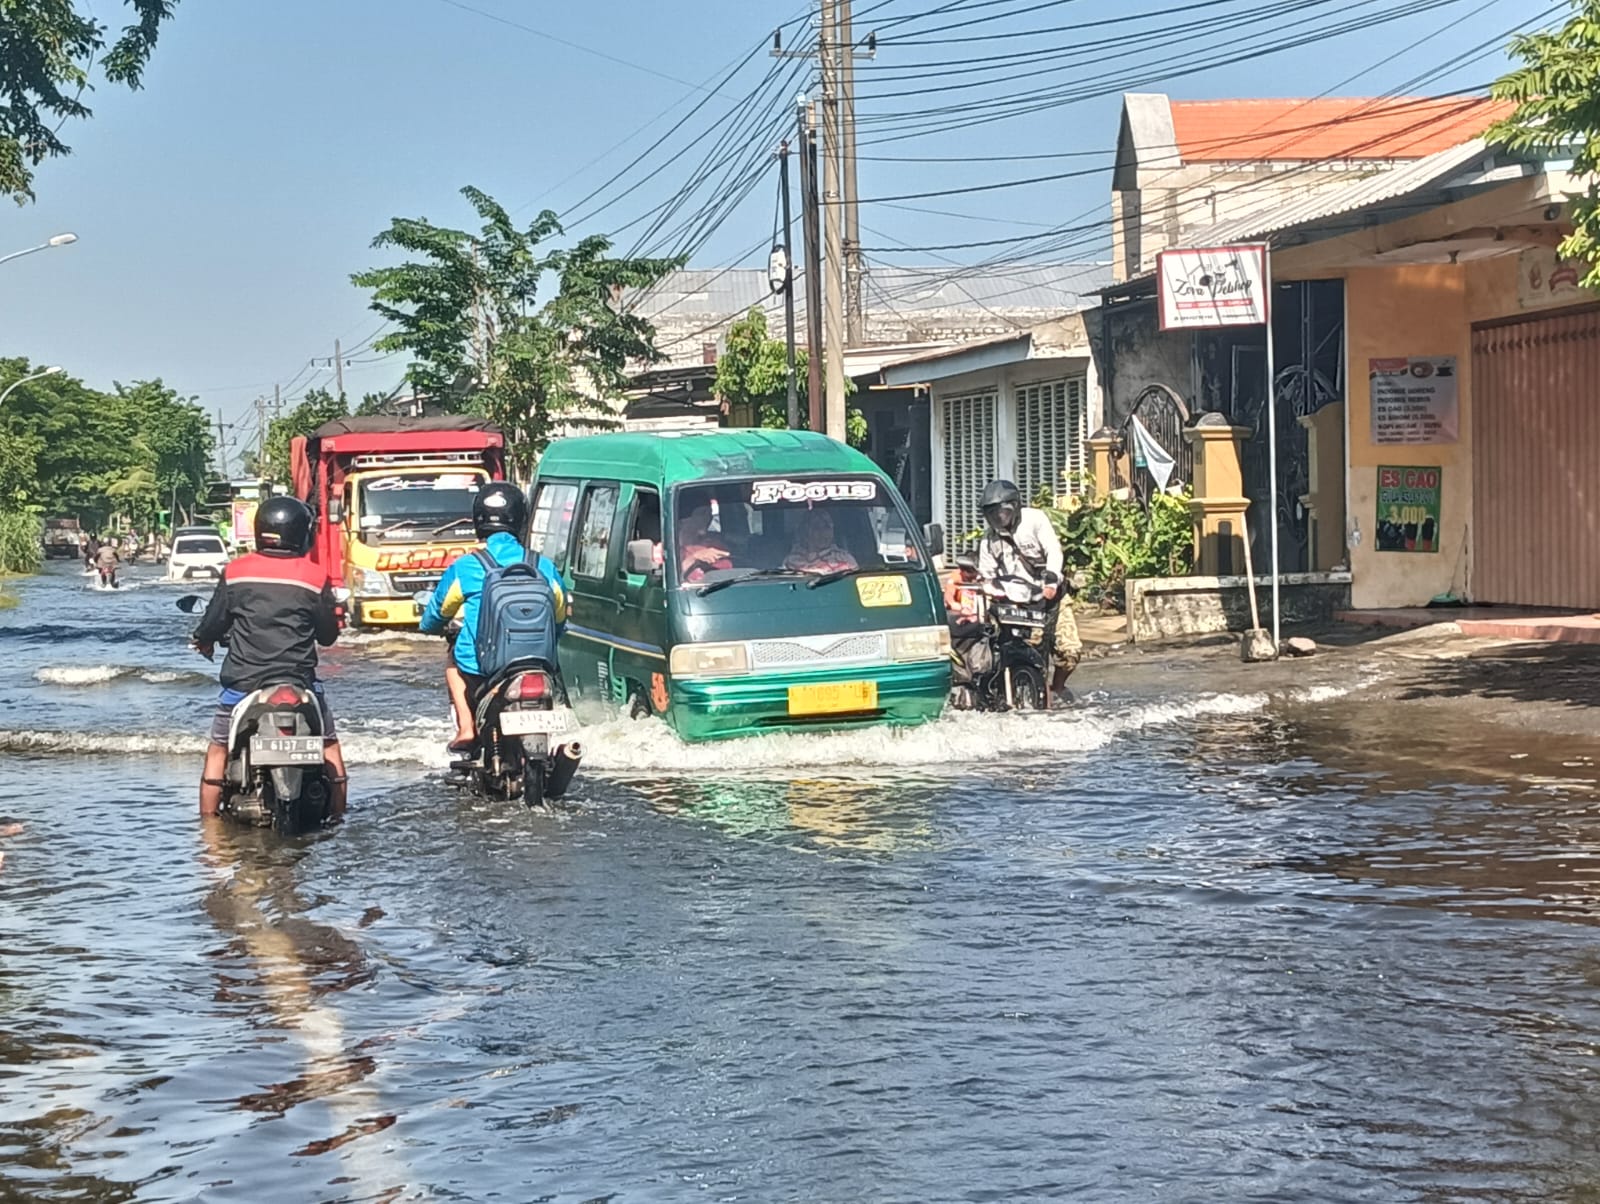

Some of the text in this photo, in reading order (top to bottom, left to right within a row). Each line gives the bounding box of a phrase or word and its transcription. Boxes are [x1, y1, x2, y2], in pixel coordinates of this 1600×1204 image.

[1380, 469, 1439, 489] ES CAO
[270, 740, 298, 751] 6137
